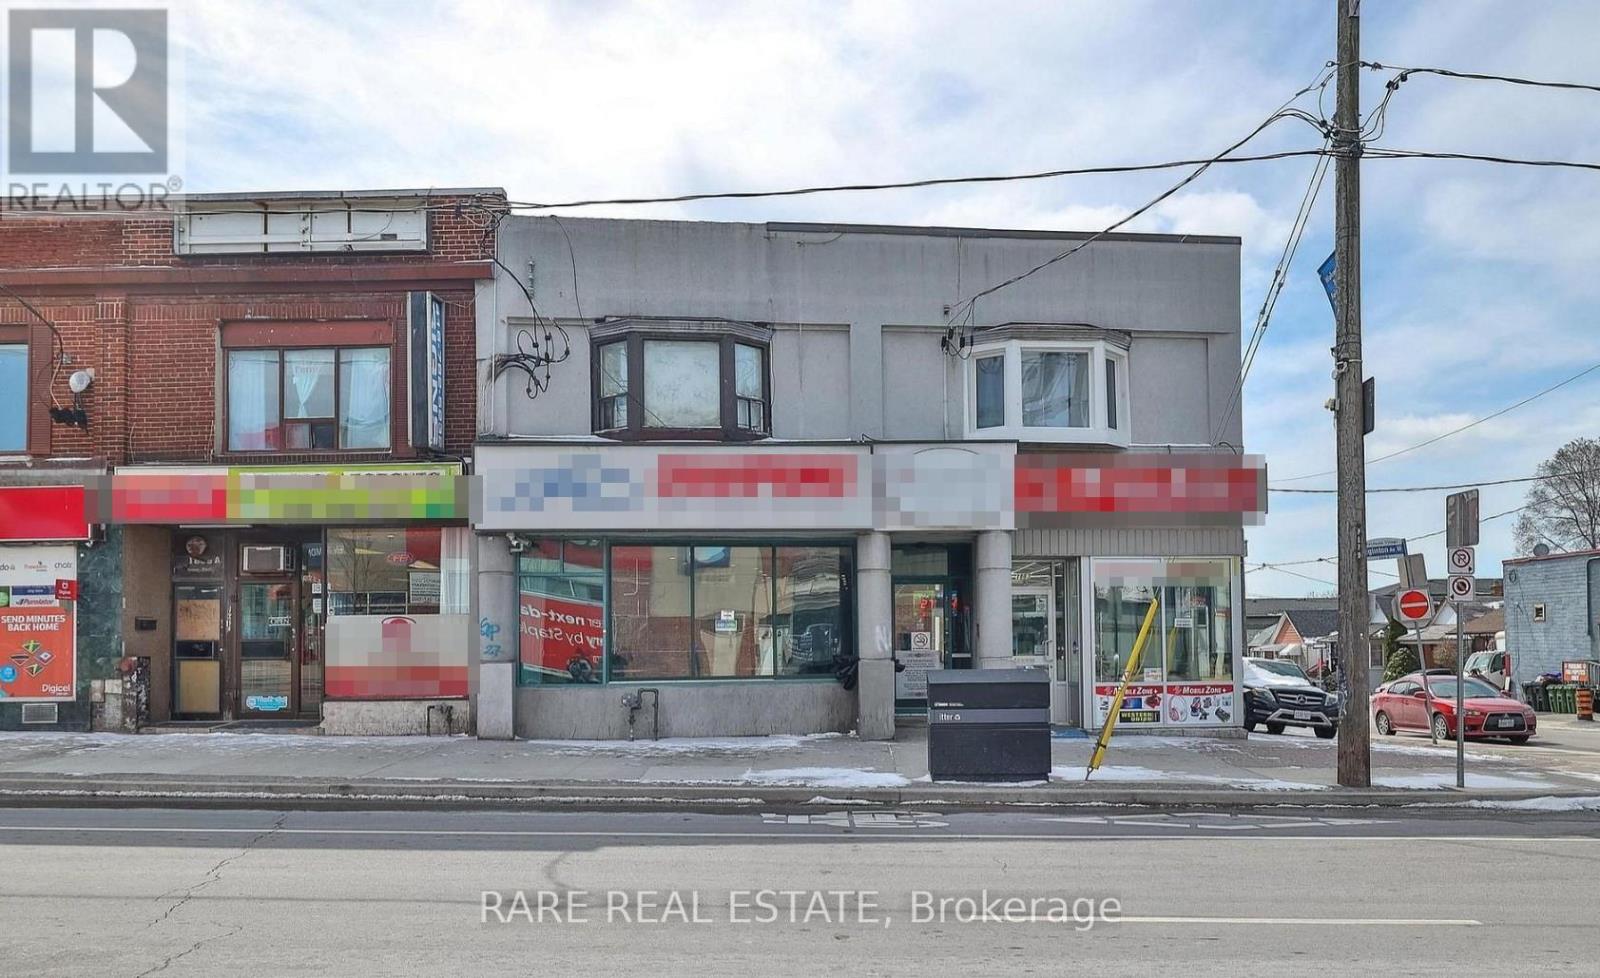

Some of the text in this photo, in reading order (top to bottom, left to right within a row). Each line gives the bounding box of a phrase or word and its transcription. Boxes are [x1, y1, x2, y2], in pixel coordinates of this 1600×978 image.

[1367, 546, 1389, 556] glinton
[0, 614, 66, 624] SEND MINUTES
[7, 623, 60, 632] BACK HOME
[42, 684, 71, 693] Digicel
